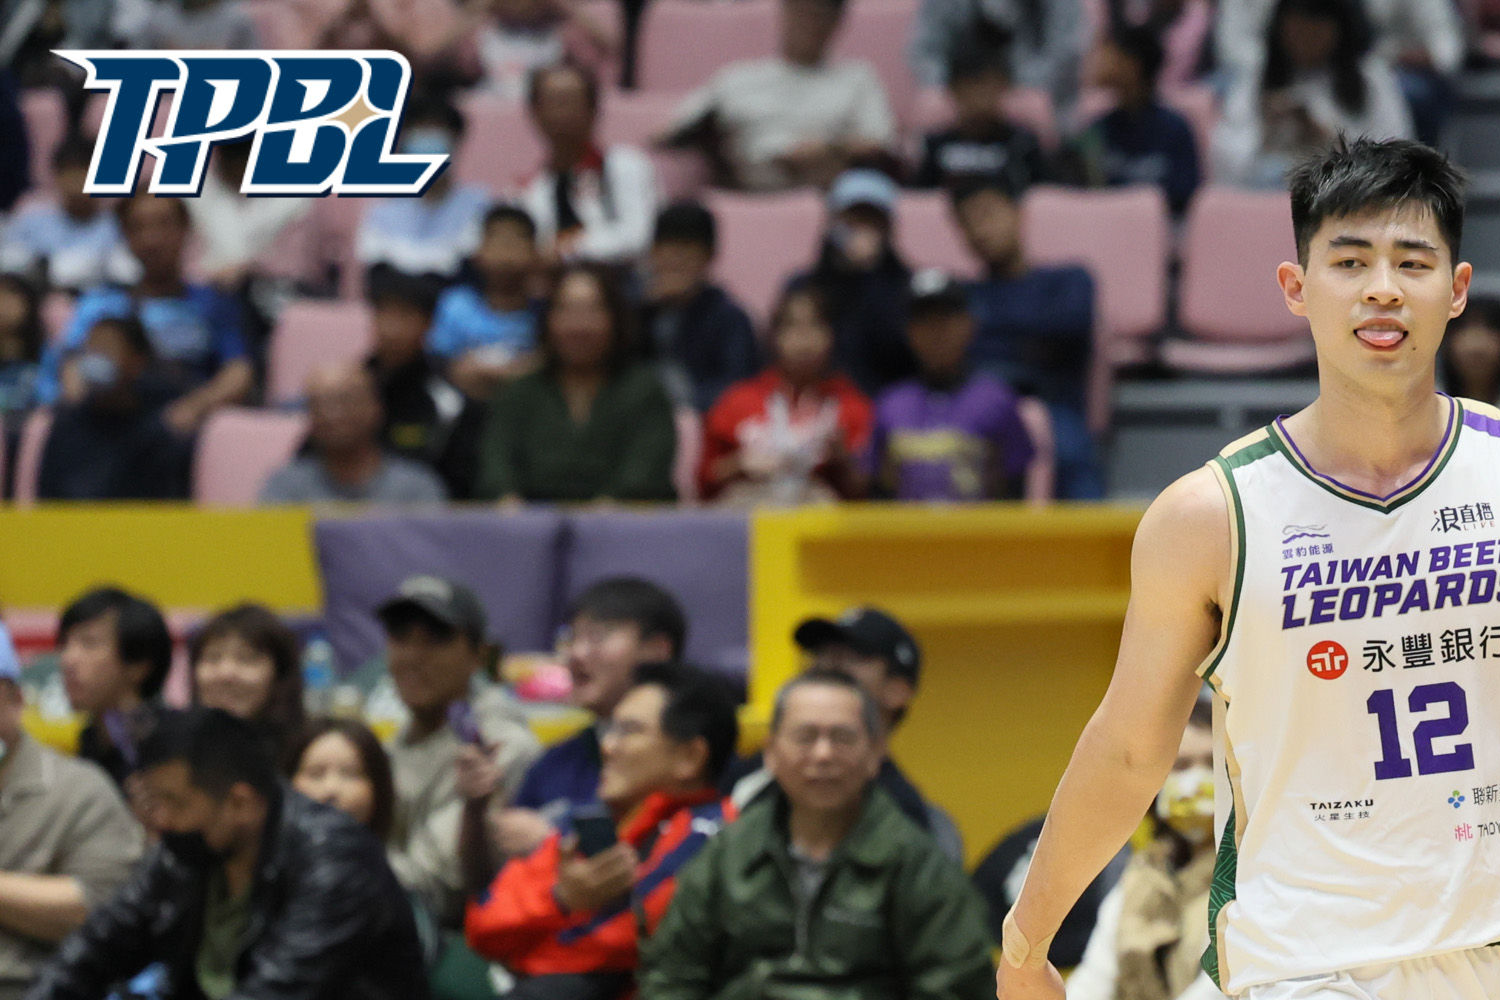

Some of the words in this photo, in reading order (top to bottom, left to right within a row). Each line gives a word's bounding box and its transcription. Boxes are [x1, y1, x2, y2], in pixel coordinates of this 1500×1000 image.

[1430, 502, 1494, 533] 浪直播
[1463, 520, 1495, 531] LIVE
[1281, 550, 1421, 591] TAIWAN
[1366, 681, 1475, 781] 12
[1310, 799, 1374, 810] TAIZAKU
[1314, 811, 1370, 822] 火星生技
